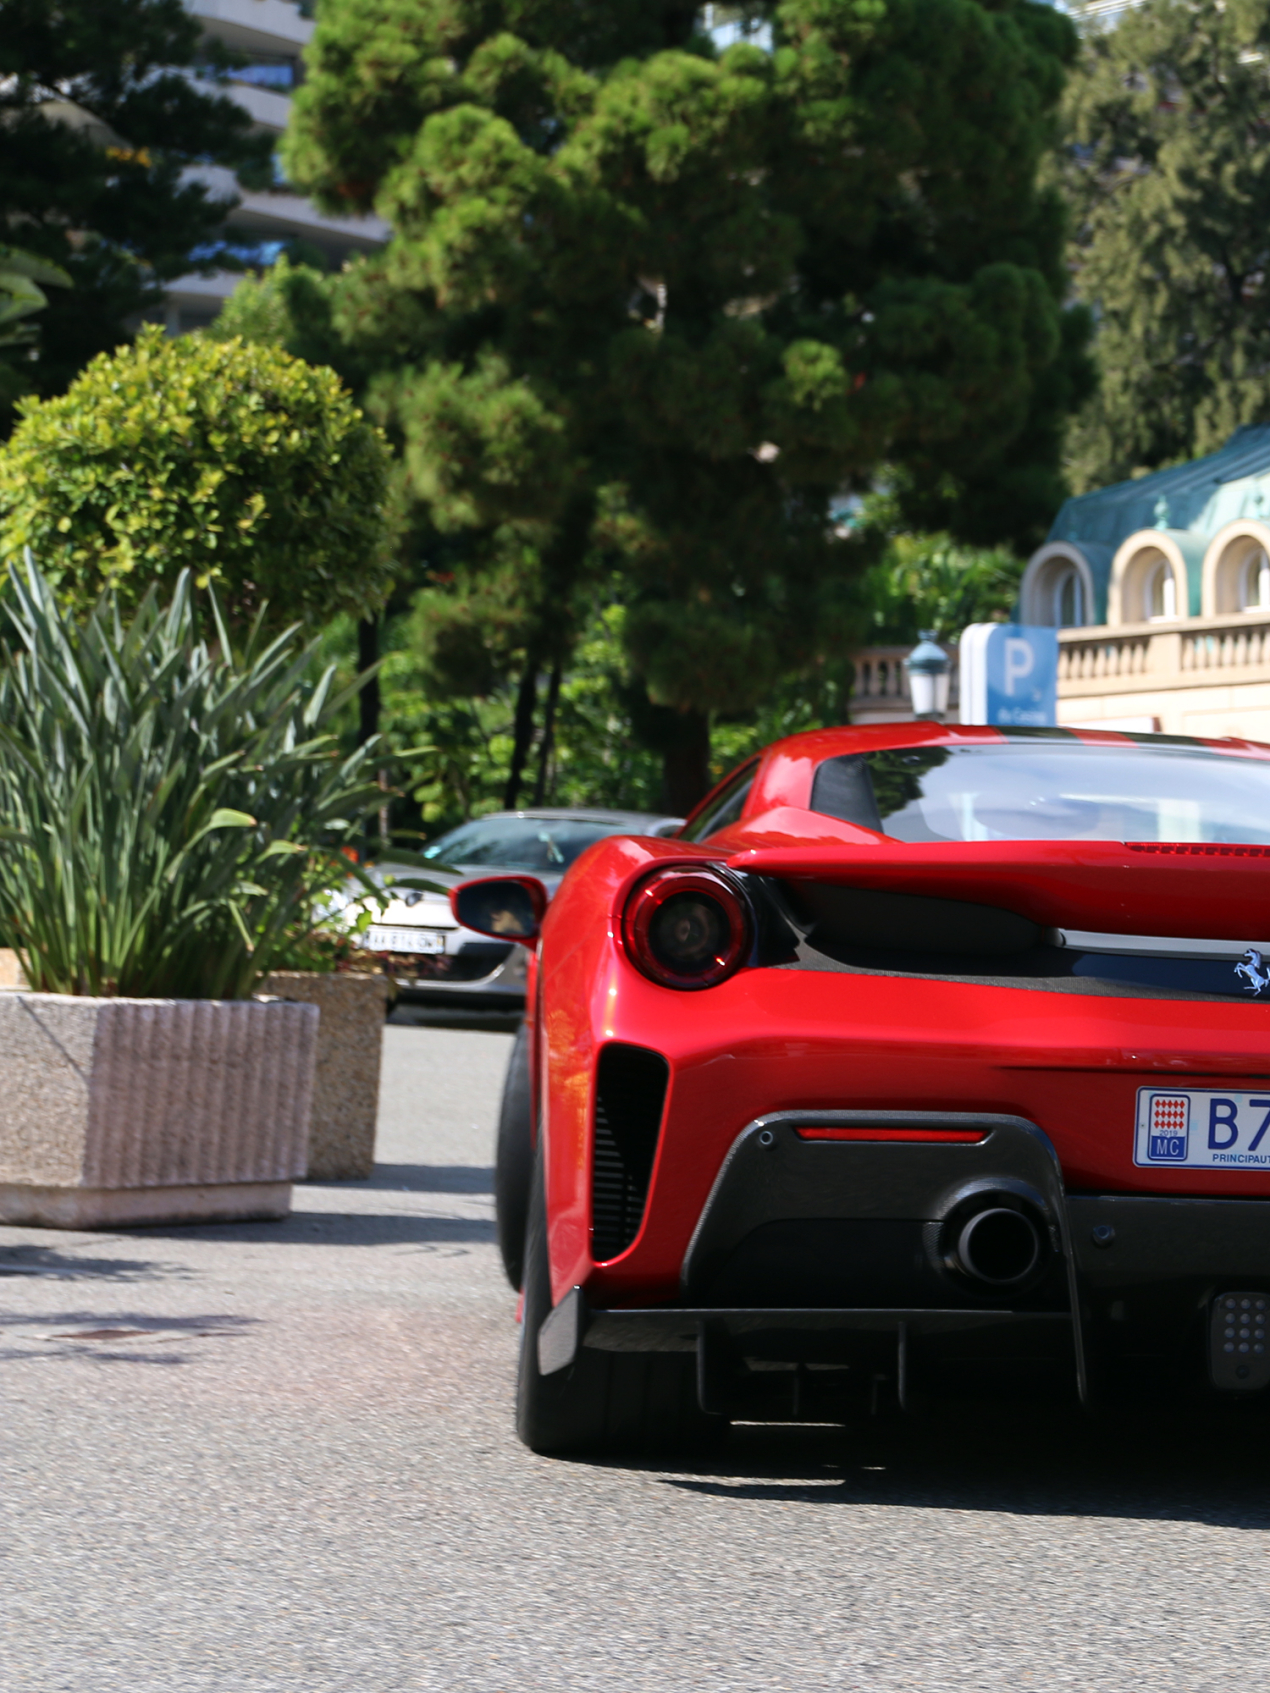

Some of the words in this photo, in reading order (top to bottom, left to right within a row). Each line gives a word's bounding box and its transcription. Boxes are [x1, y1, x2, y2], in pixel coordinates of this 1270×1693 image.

[1004, 638, 1034, 696] P
[1159, 1129, 1178, 1137] 2019
[1156, 1139, 1179, 1156] MC
